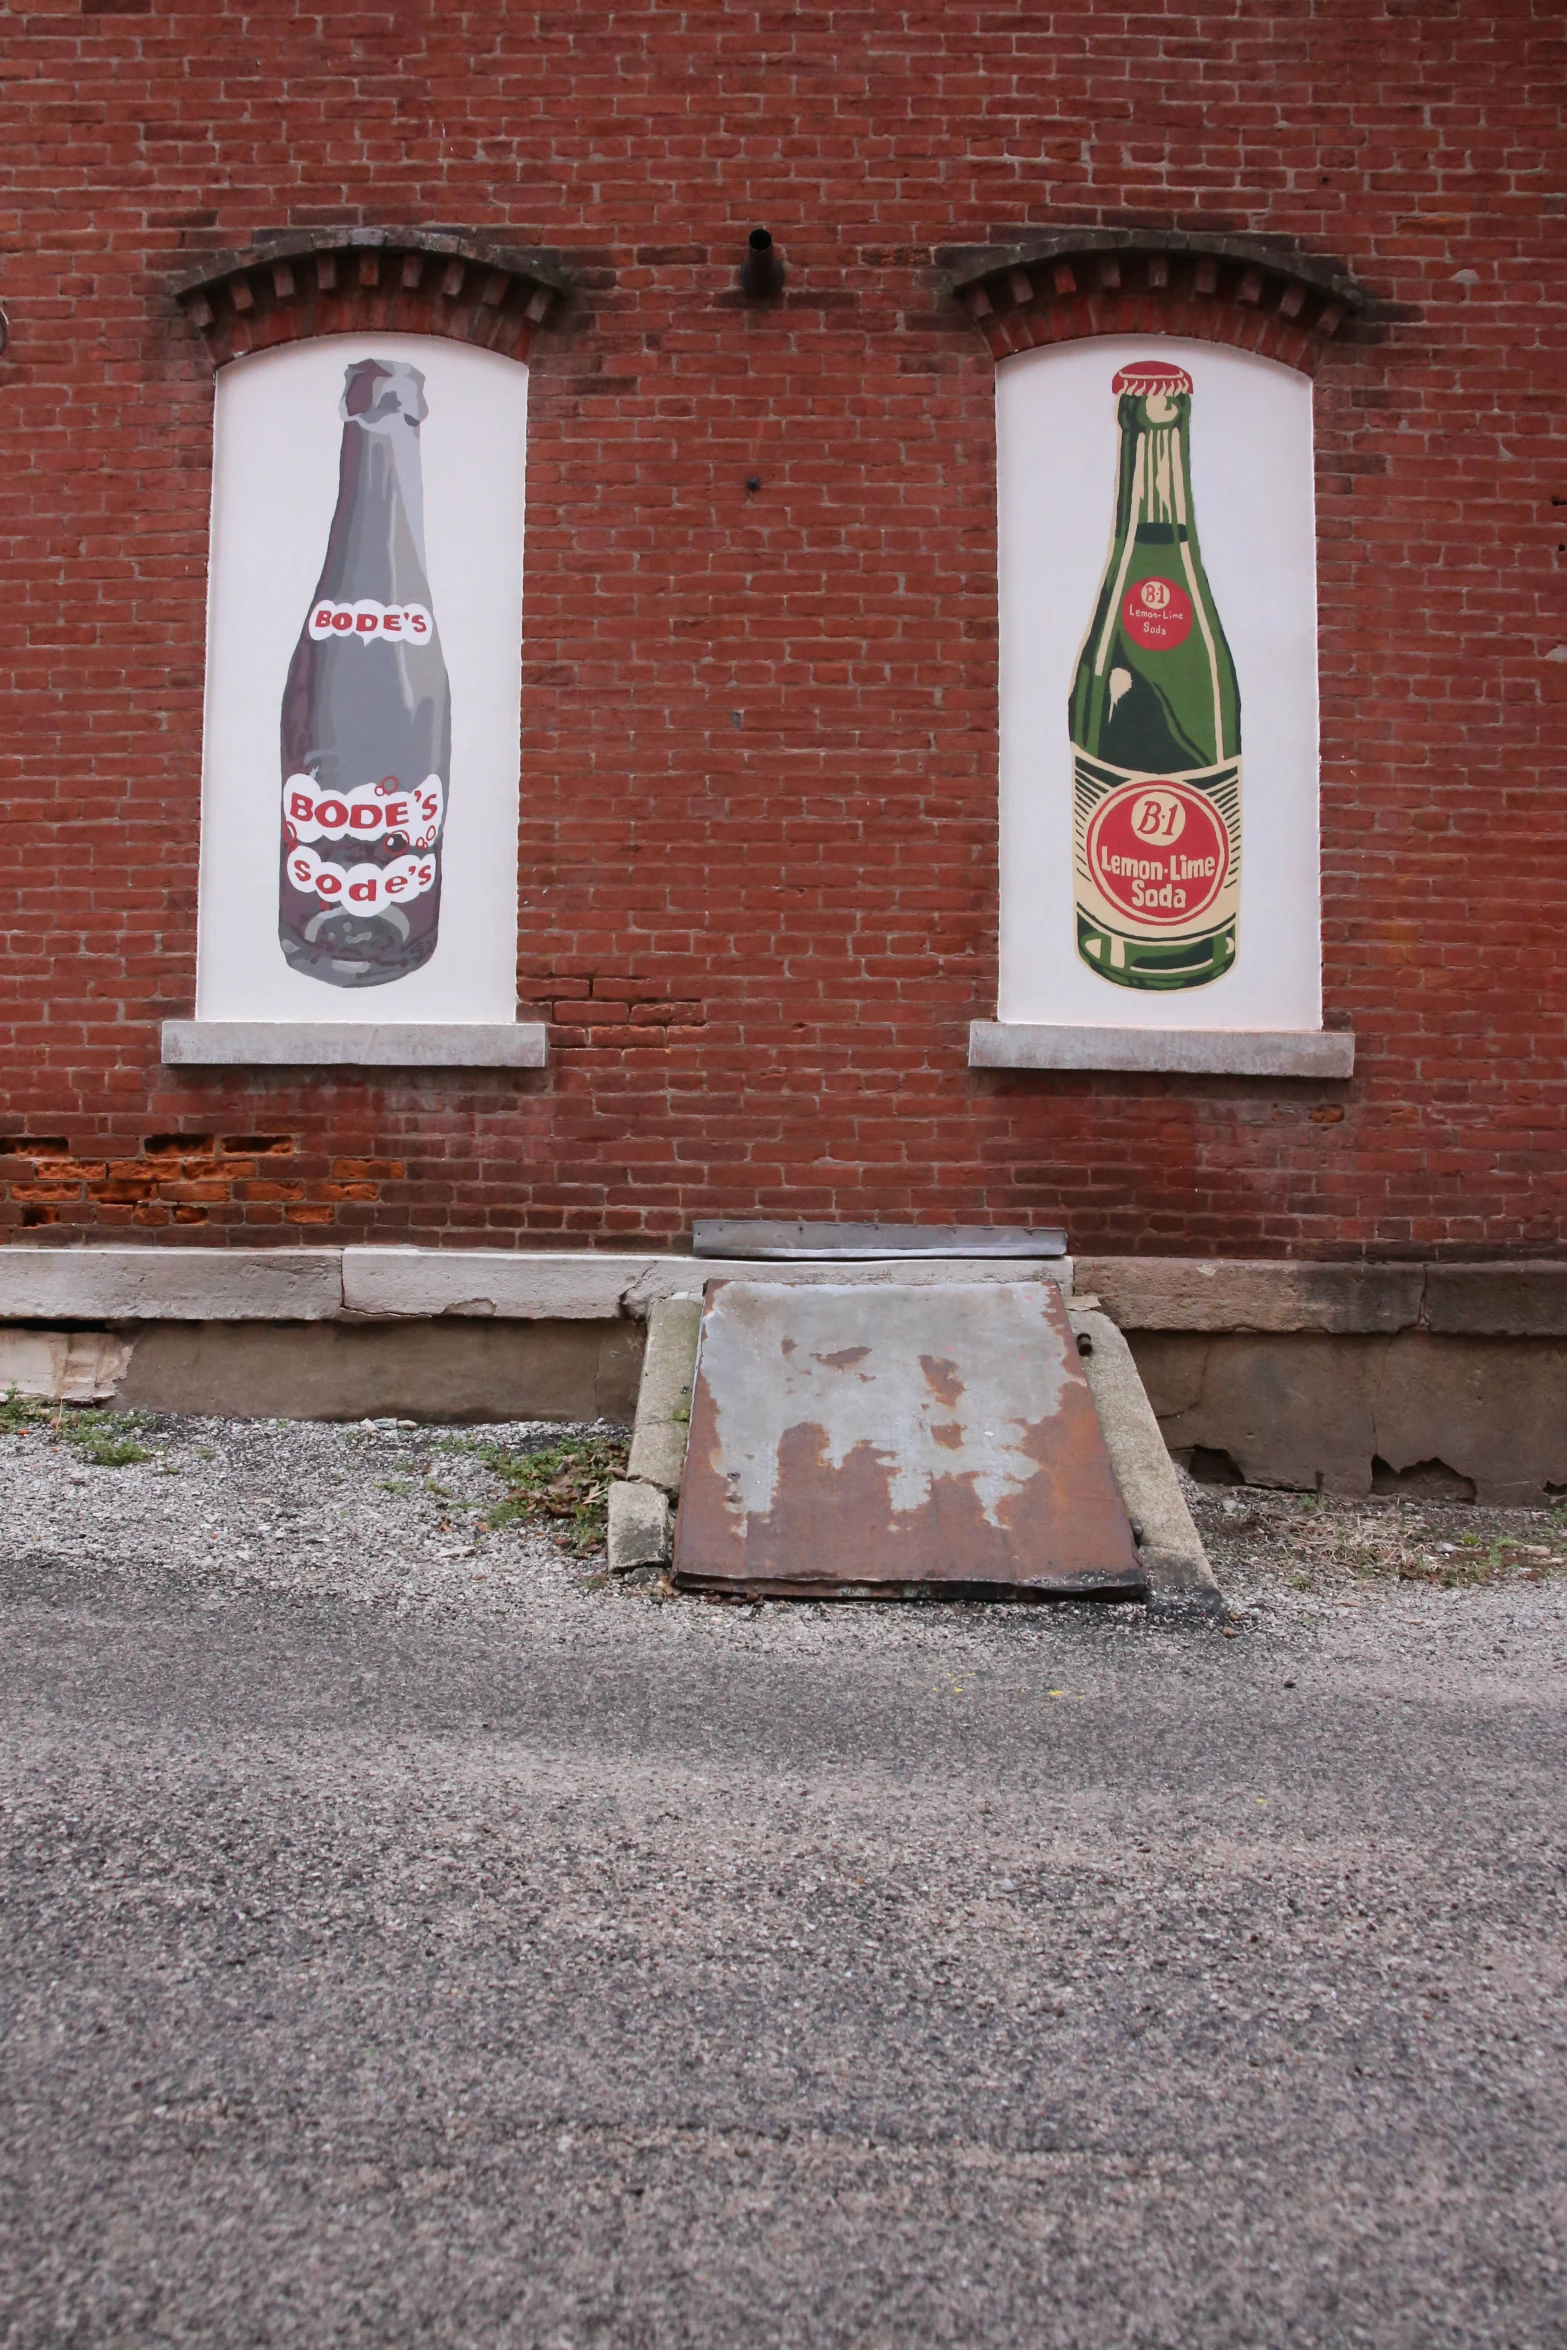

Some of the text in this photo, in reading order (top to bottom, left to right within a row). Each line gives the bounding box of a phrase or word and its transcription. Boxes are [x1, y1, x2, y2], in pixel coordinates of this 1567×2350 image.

[315, 610, 428, 633] BODE'S
[1143, 621, 1167, 636] Soda
[289, 789, 438, 829] BODE'S
[293, 859, 432, 902] Sode's
[1131, 880, 1187, 909] Soda
